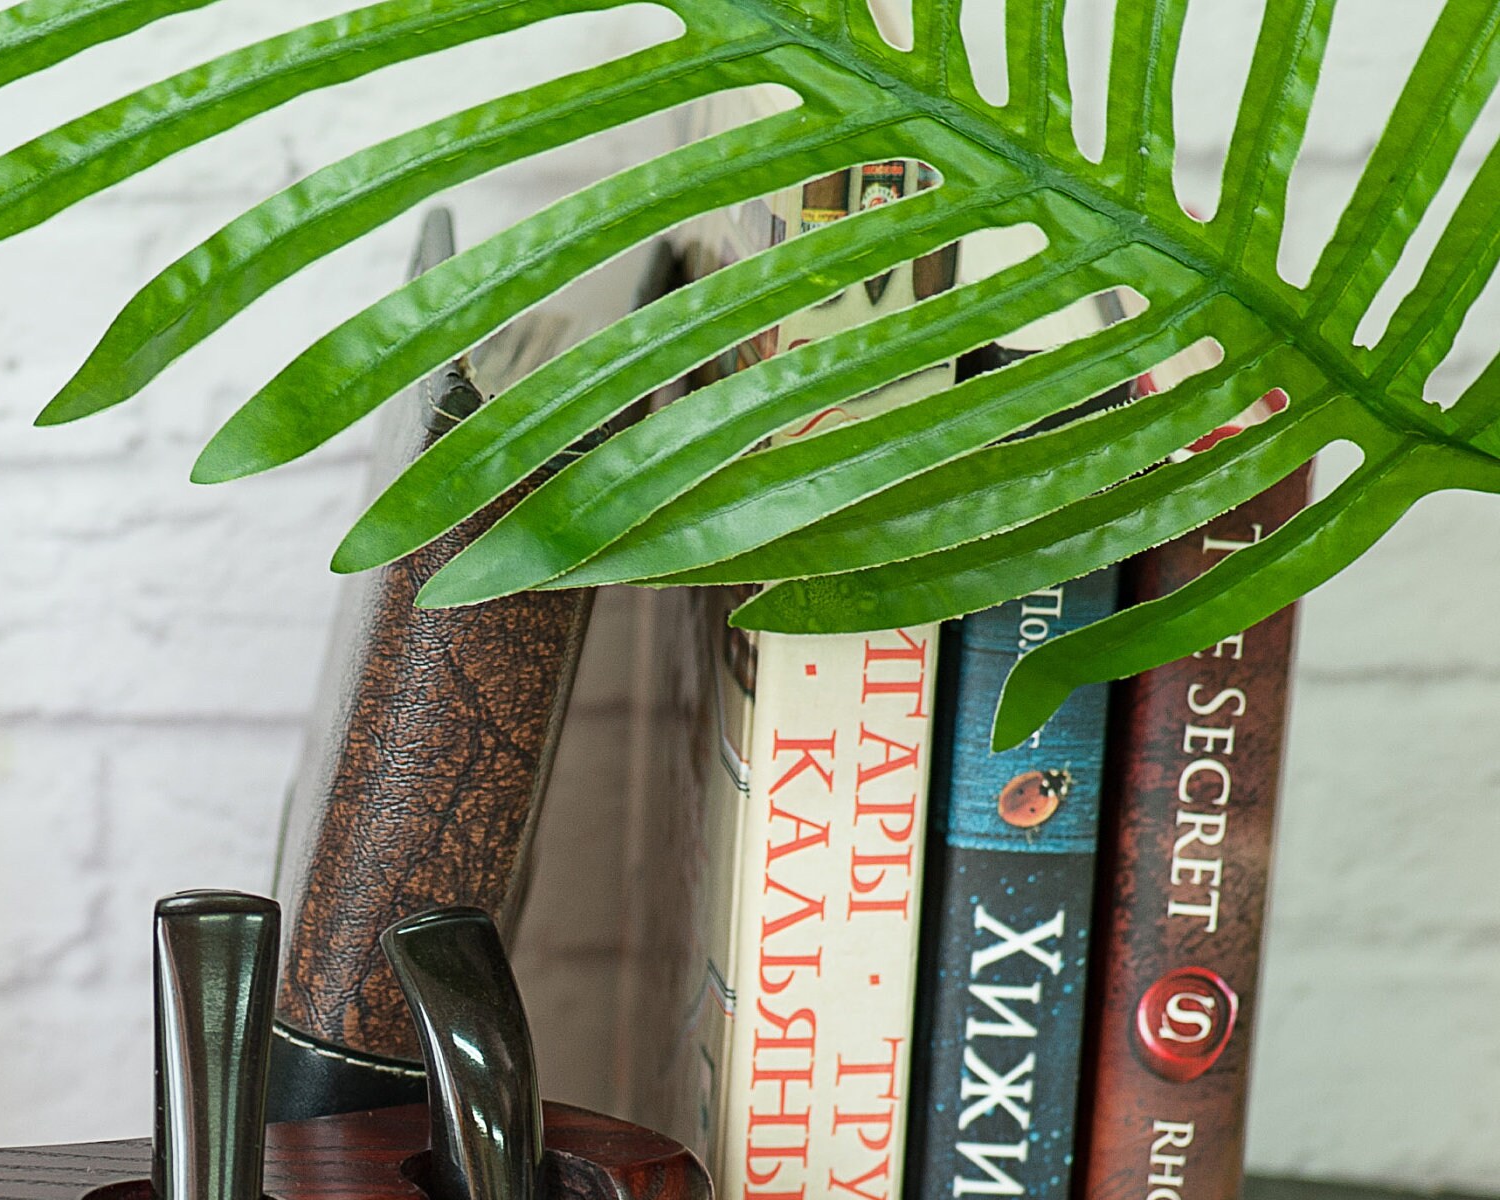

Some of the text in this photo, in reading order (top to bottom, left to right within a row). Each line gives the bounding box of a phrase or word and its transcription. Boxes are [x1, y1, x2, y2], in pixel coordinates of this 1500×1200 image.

[845, 629, 928, 921] ИГАРЫ
[1166, 523, 1263, 933] TE SECRET
